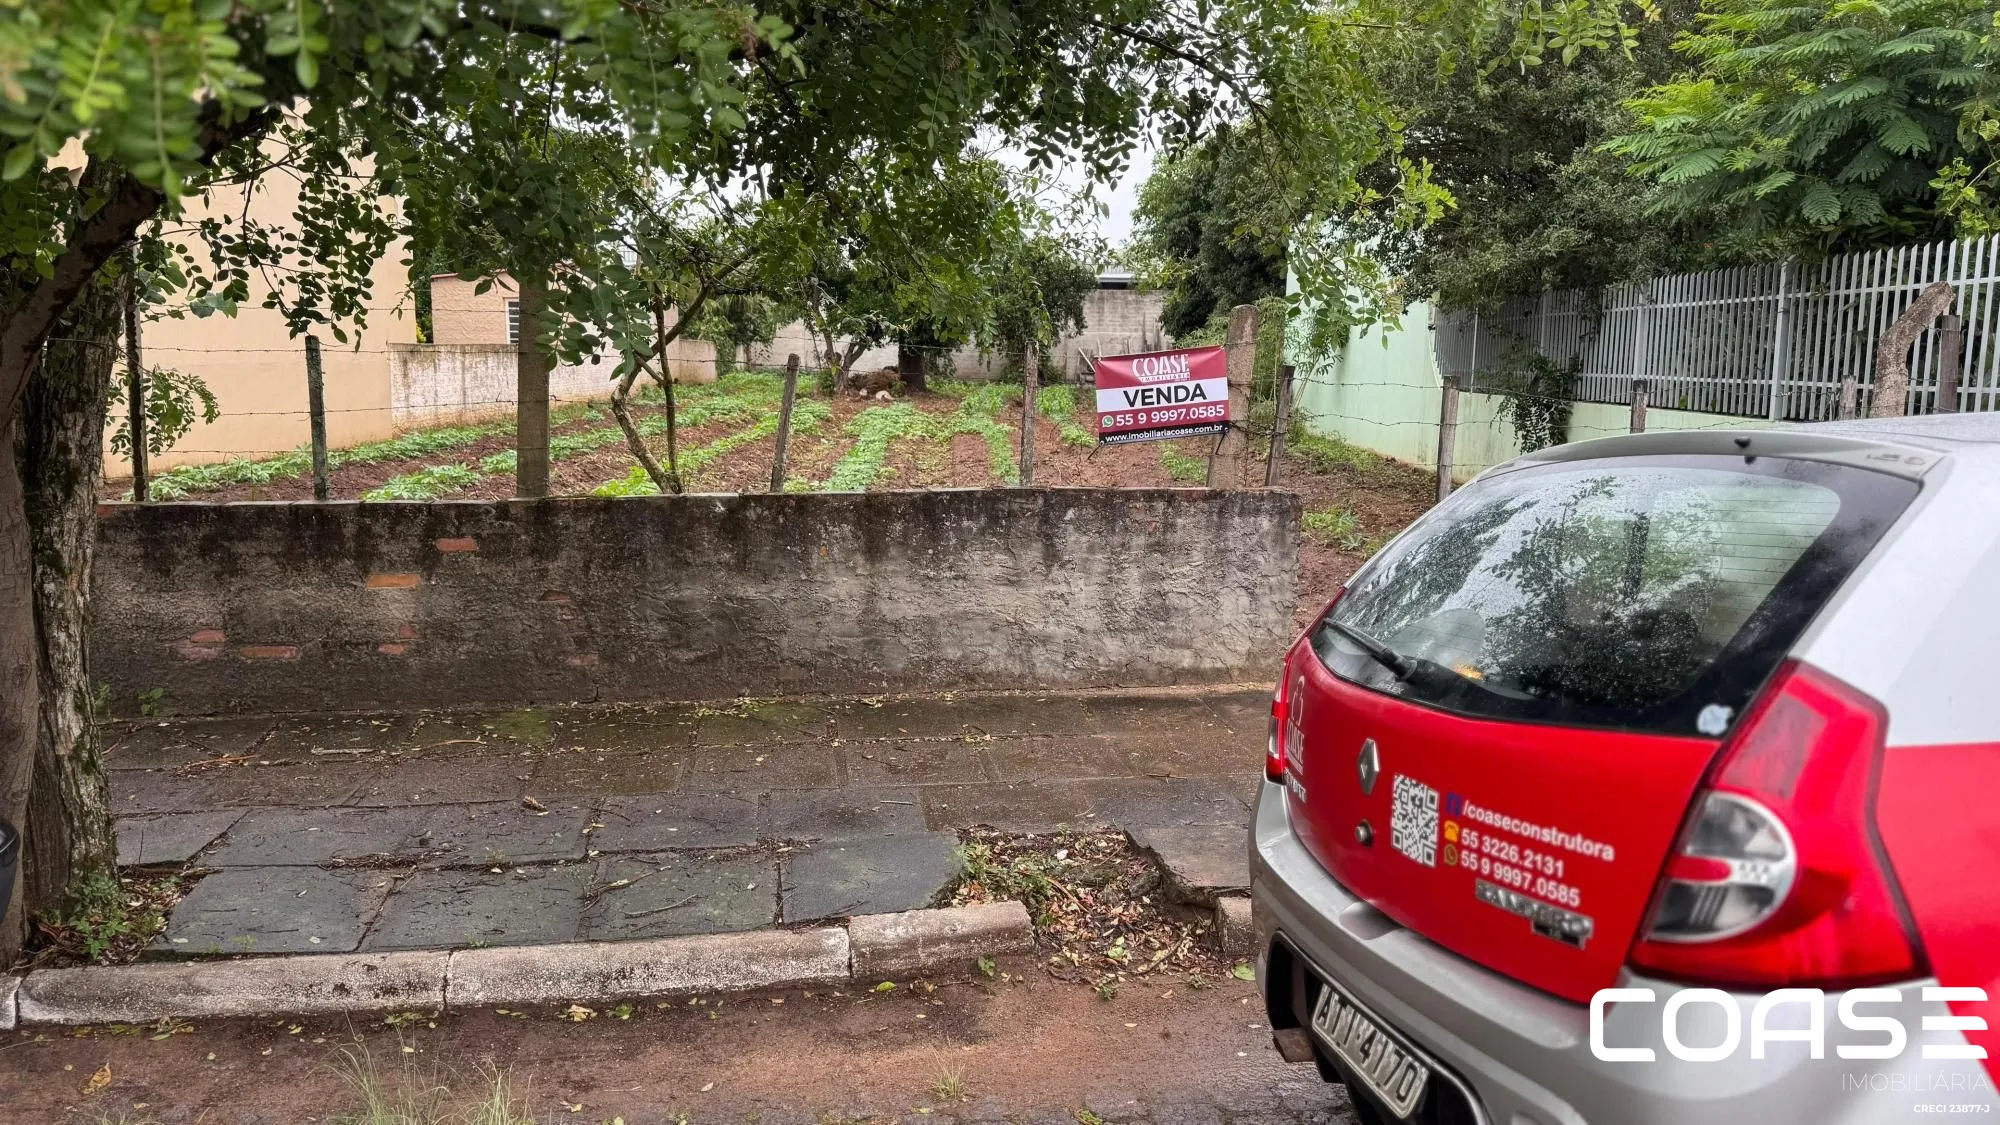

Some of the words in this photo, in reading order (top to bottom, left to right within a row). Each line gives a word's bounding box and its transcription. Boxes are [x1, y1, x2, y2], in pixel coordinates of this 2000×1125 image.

[1132, 354, 1189, 377] COASE
[1123, 383, 1207, 408] VENDA
[1116, 413, 1133, 426] 55
[1138, 413, 1147, 424] 9
[1151, 405, 1225, 423] 9997.0585
[1105, 424, 1223, 443] www.imobiliariacoase.com.br
[1462, 800, 1616, 862] /coaseconstrutora
[1461, 829, 1479, 849] 55
[1482, 835, 1565, 878] 3226.2131
[1461, 851, 1478, 870] 55
[1481, 859, 1490, 875] 9
[1493, 862, 1581, 908] 9997.0585
